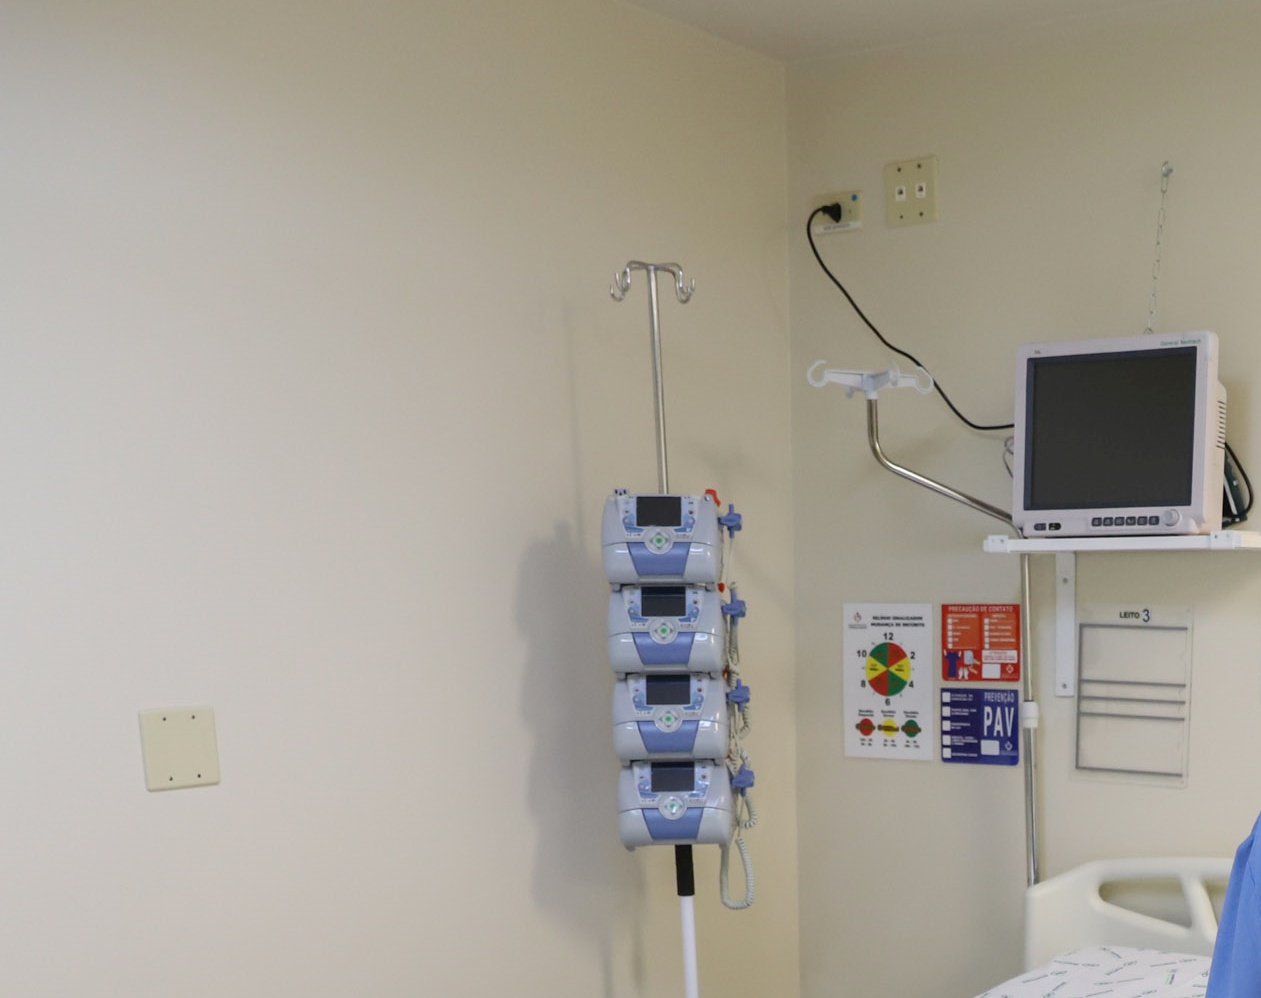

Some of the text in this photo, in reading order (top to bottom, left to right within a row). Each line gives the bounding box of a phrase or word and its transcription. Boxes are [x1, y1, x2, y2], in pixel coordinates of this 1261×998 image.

[1119, 609, 1151, 623] LEITO 3
[883, 632, 894, 641] 12
[857, 649, 867, 658] 10
[910, 651, 916, 660] 2
[860, 680, 866, 688] 8
[908, 680, 914, 688] 4
[885, 698, 891, 706] 6
[984, 690, 1015, 705] PREVENÇÃO
[984, 706, 1015, 737] PAV
